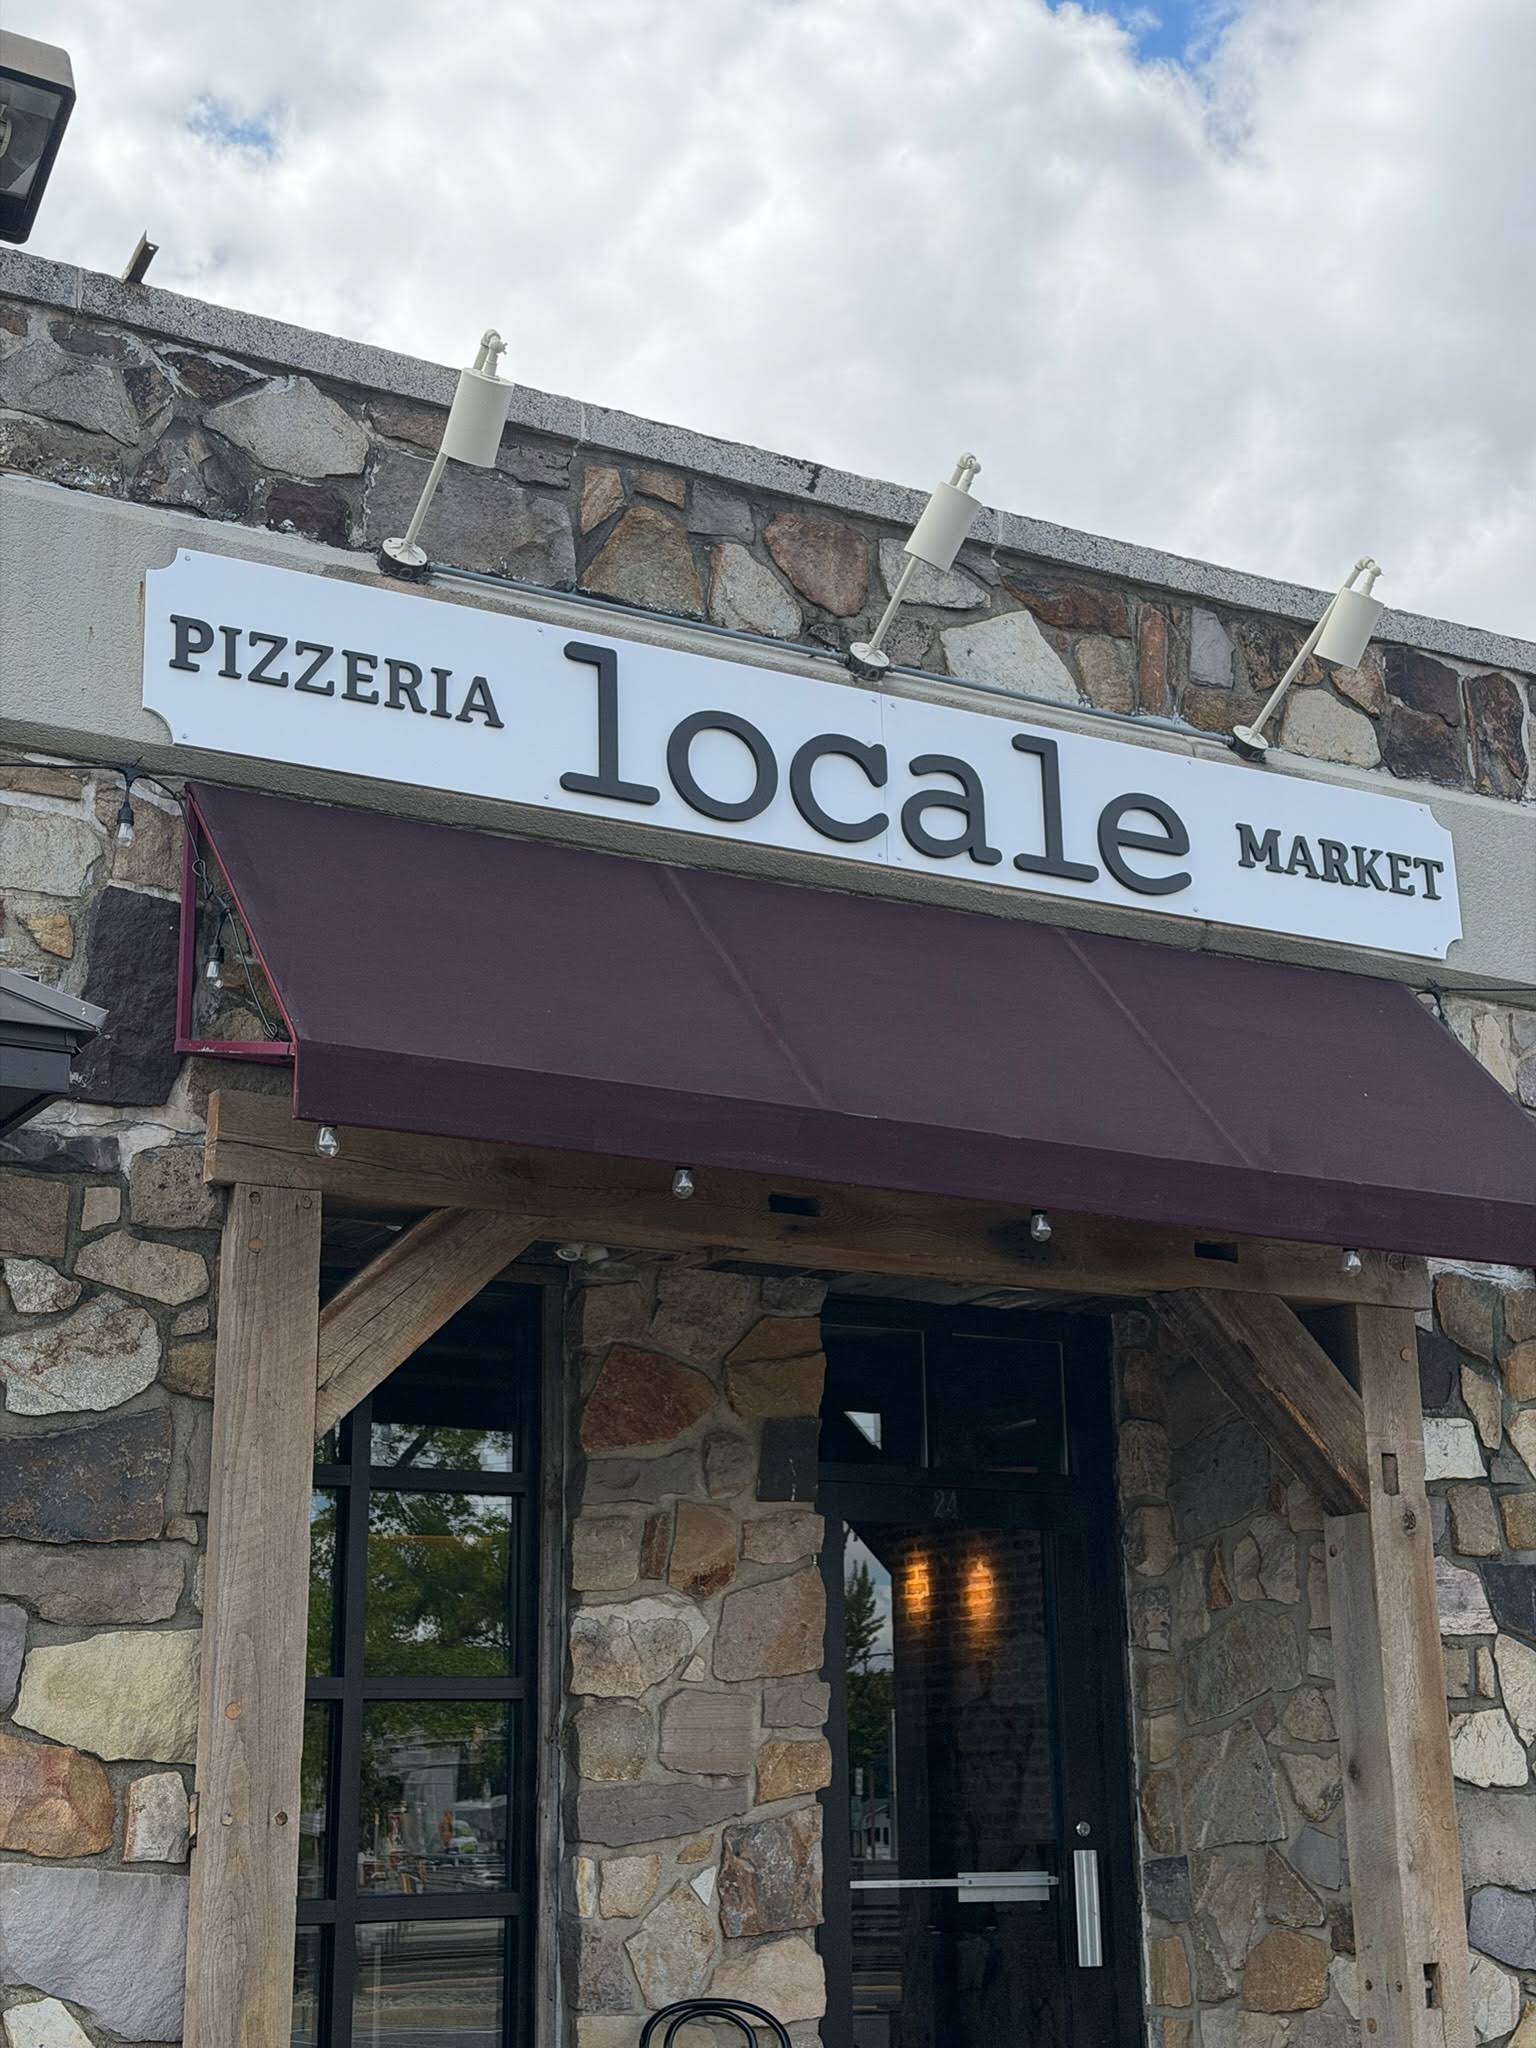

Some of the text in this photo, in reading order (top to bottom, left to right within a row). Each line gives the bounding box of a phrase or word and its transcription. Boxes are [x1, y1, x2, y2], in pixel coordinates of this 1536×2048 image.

[168, 614, 505, 730] PIZZERIA
[559, 640, 1193, 897] locale
[1235, 822, 1460, 901] MARKET
[934, 1489, 959, 1519] 24
